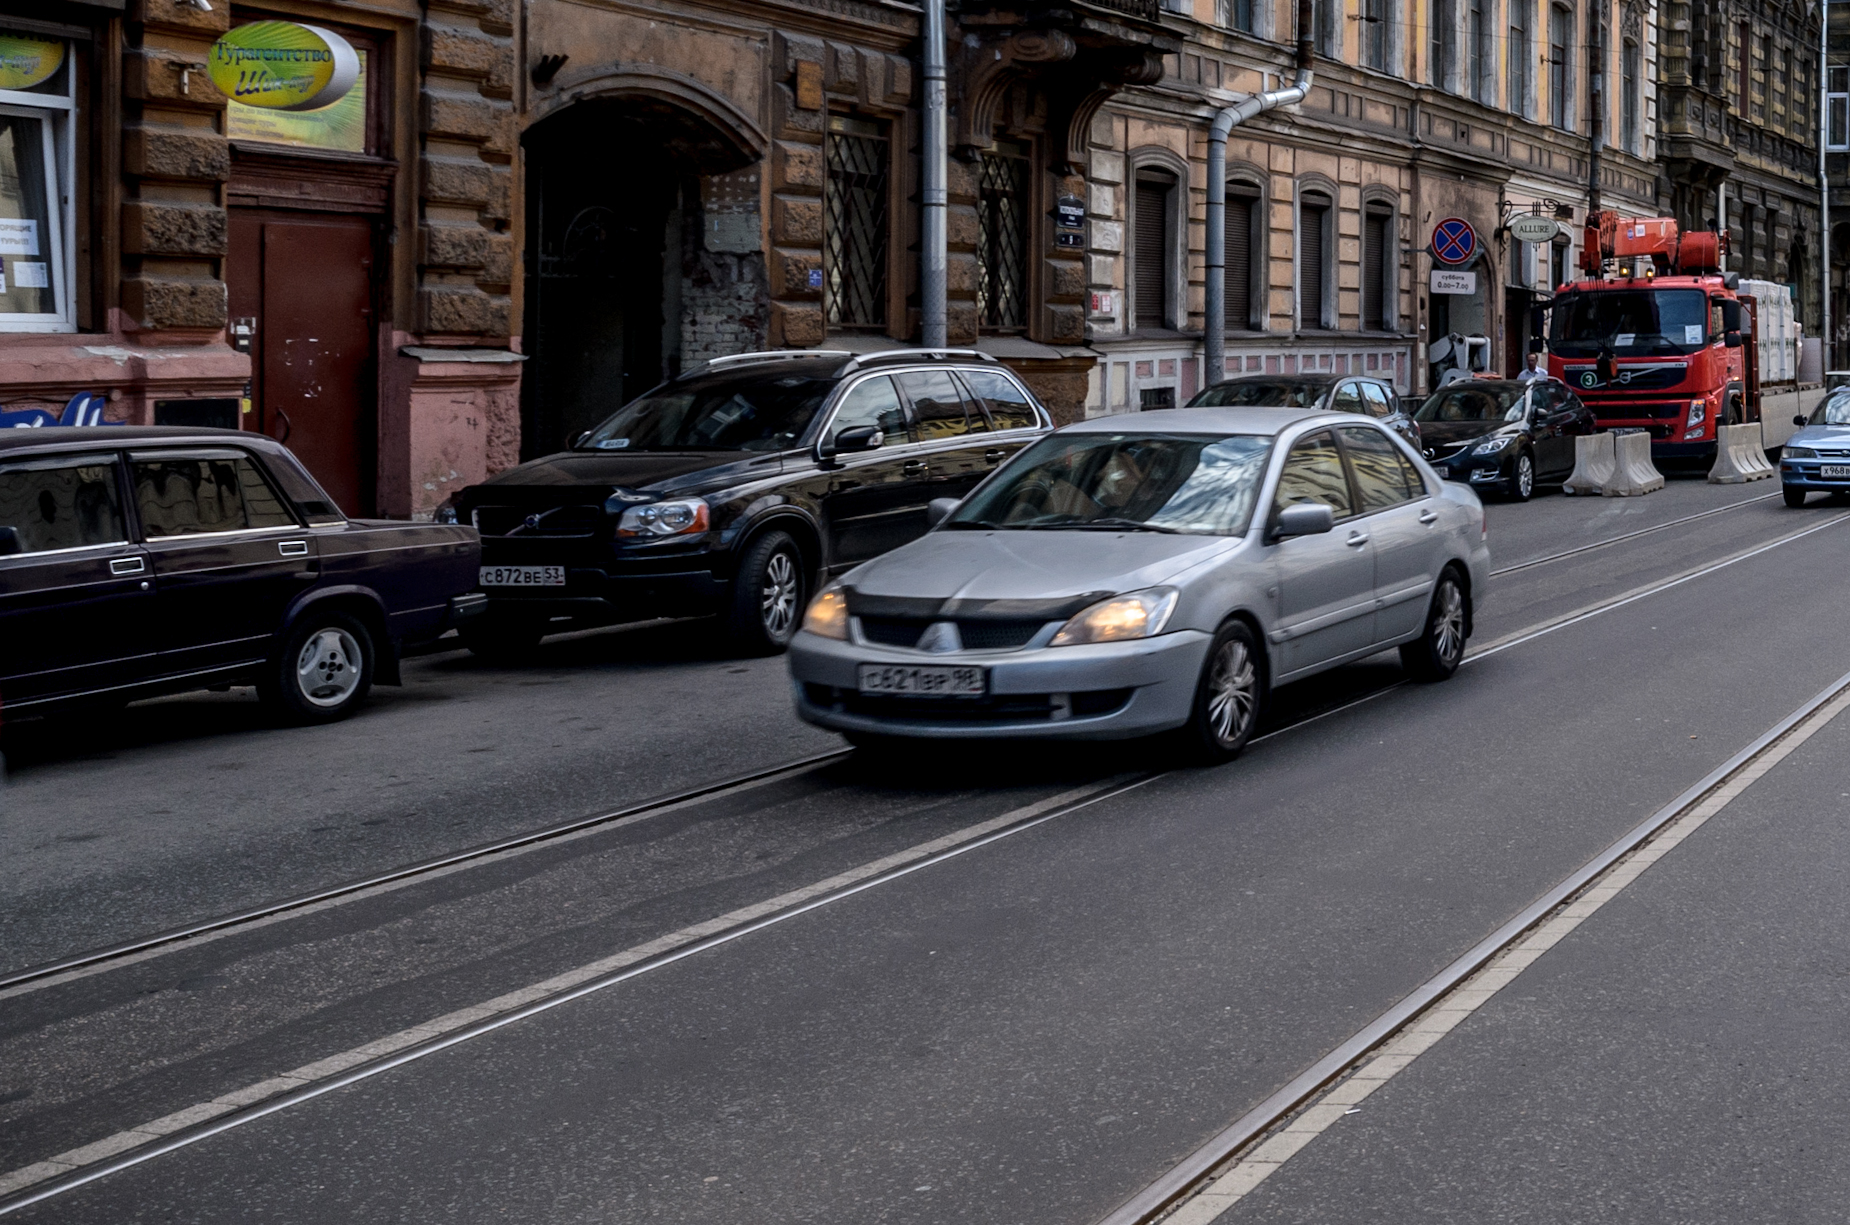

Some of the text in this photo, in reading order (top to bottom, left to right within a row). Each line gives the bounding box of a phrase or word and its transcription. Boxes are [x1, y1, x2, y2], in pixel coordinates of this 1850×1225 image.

[216, 42, 332, 66] Турагентство
[0, 224, 32, 233] ОРЯЩИЕ
[1441, 274, 1465, 282] суббота
[1585, 375, 1593, 386] 3
[485, 567, 560, 584] С872ВЕ 53
